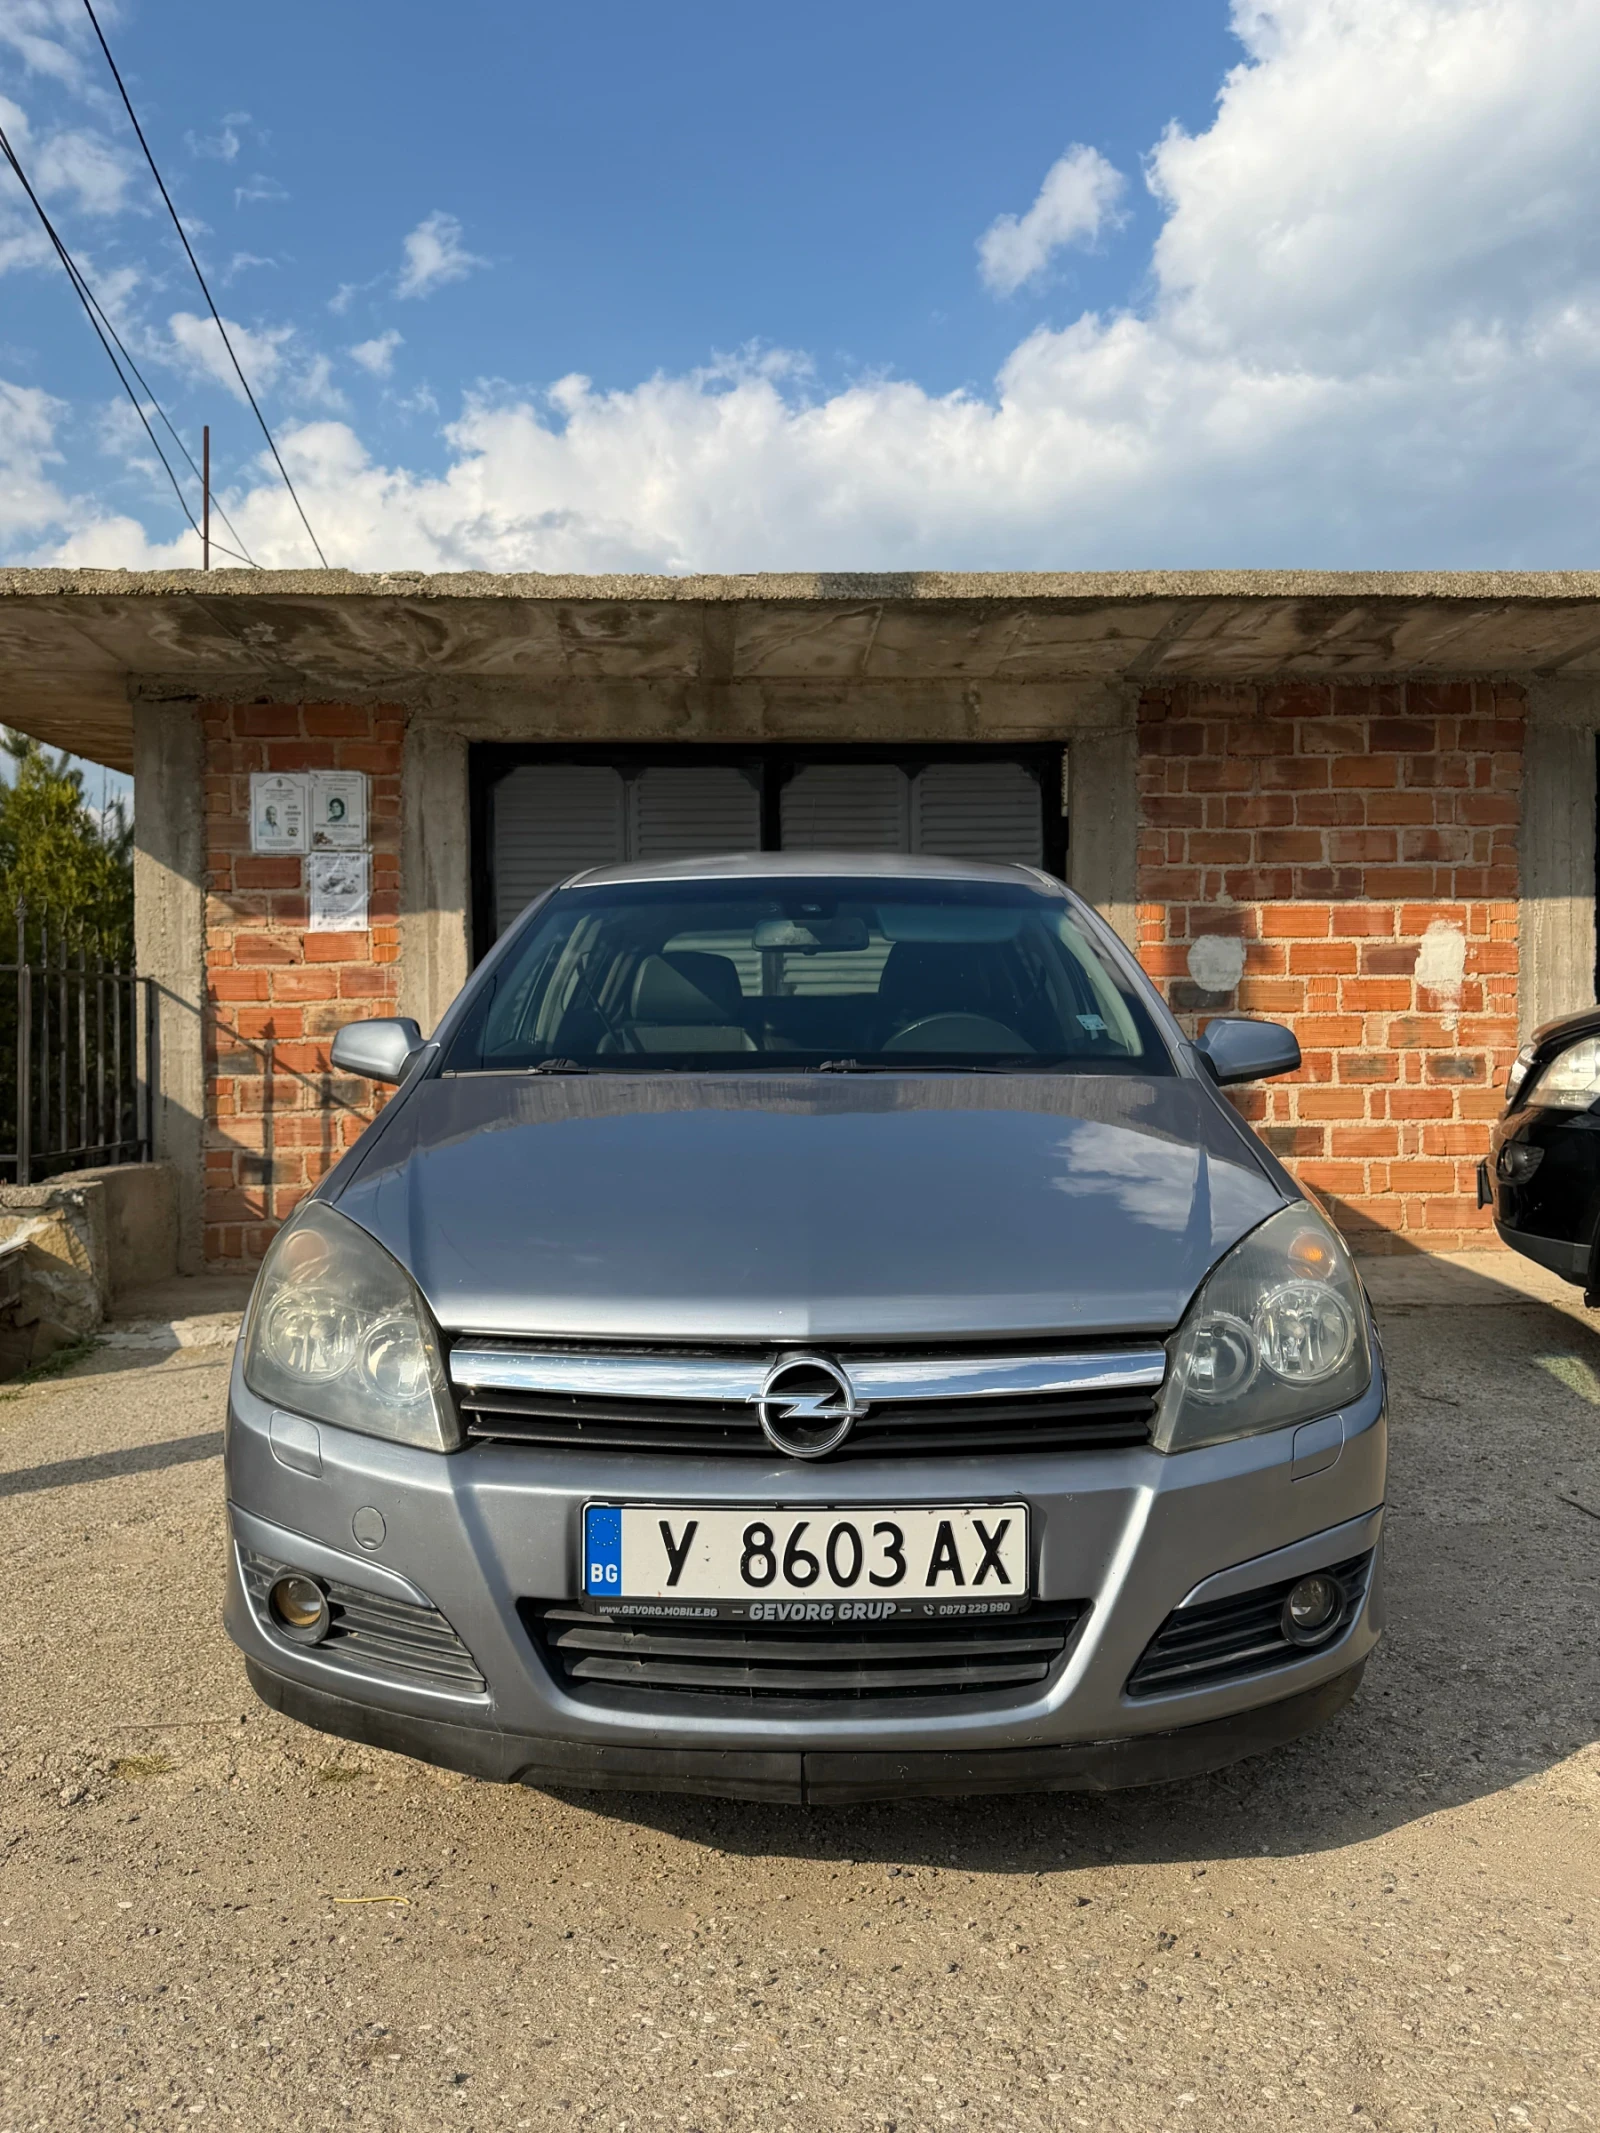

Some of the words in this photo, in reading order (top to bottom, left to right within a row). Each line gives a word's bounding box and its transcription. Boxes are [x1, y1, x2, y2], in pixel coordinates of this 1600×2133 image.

[740, 1521, 907, 1588] 8603
[924, 1519, 1012, 1587] AX
[590, 1563, 618, 1583] BG
[599, 1605, 718, 1617] www.GEVORG.MOBILE.BG
[749, 1604, 835, 1620] GEVORG
[838, 1602, 897, 1619] GRUP
[939, 1605, 966, 1615] 0878
